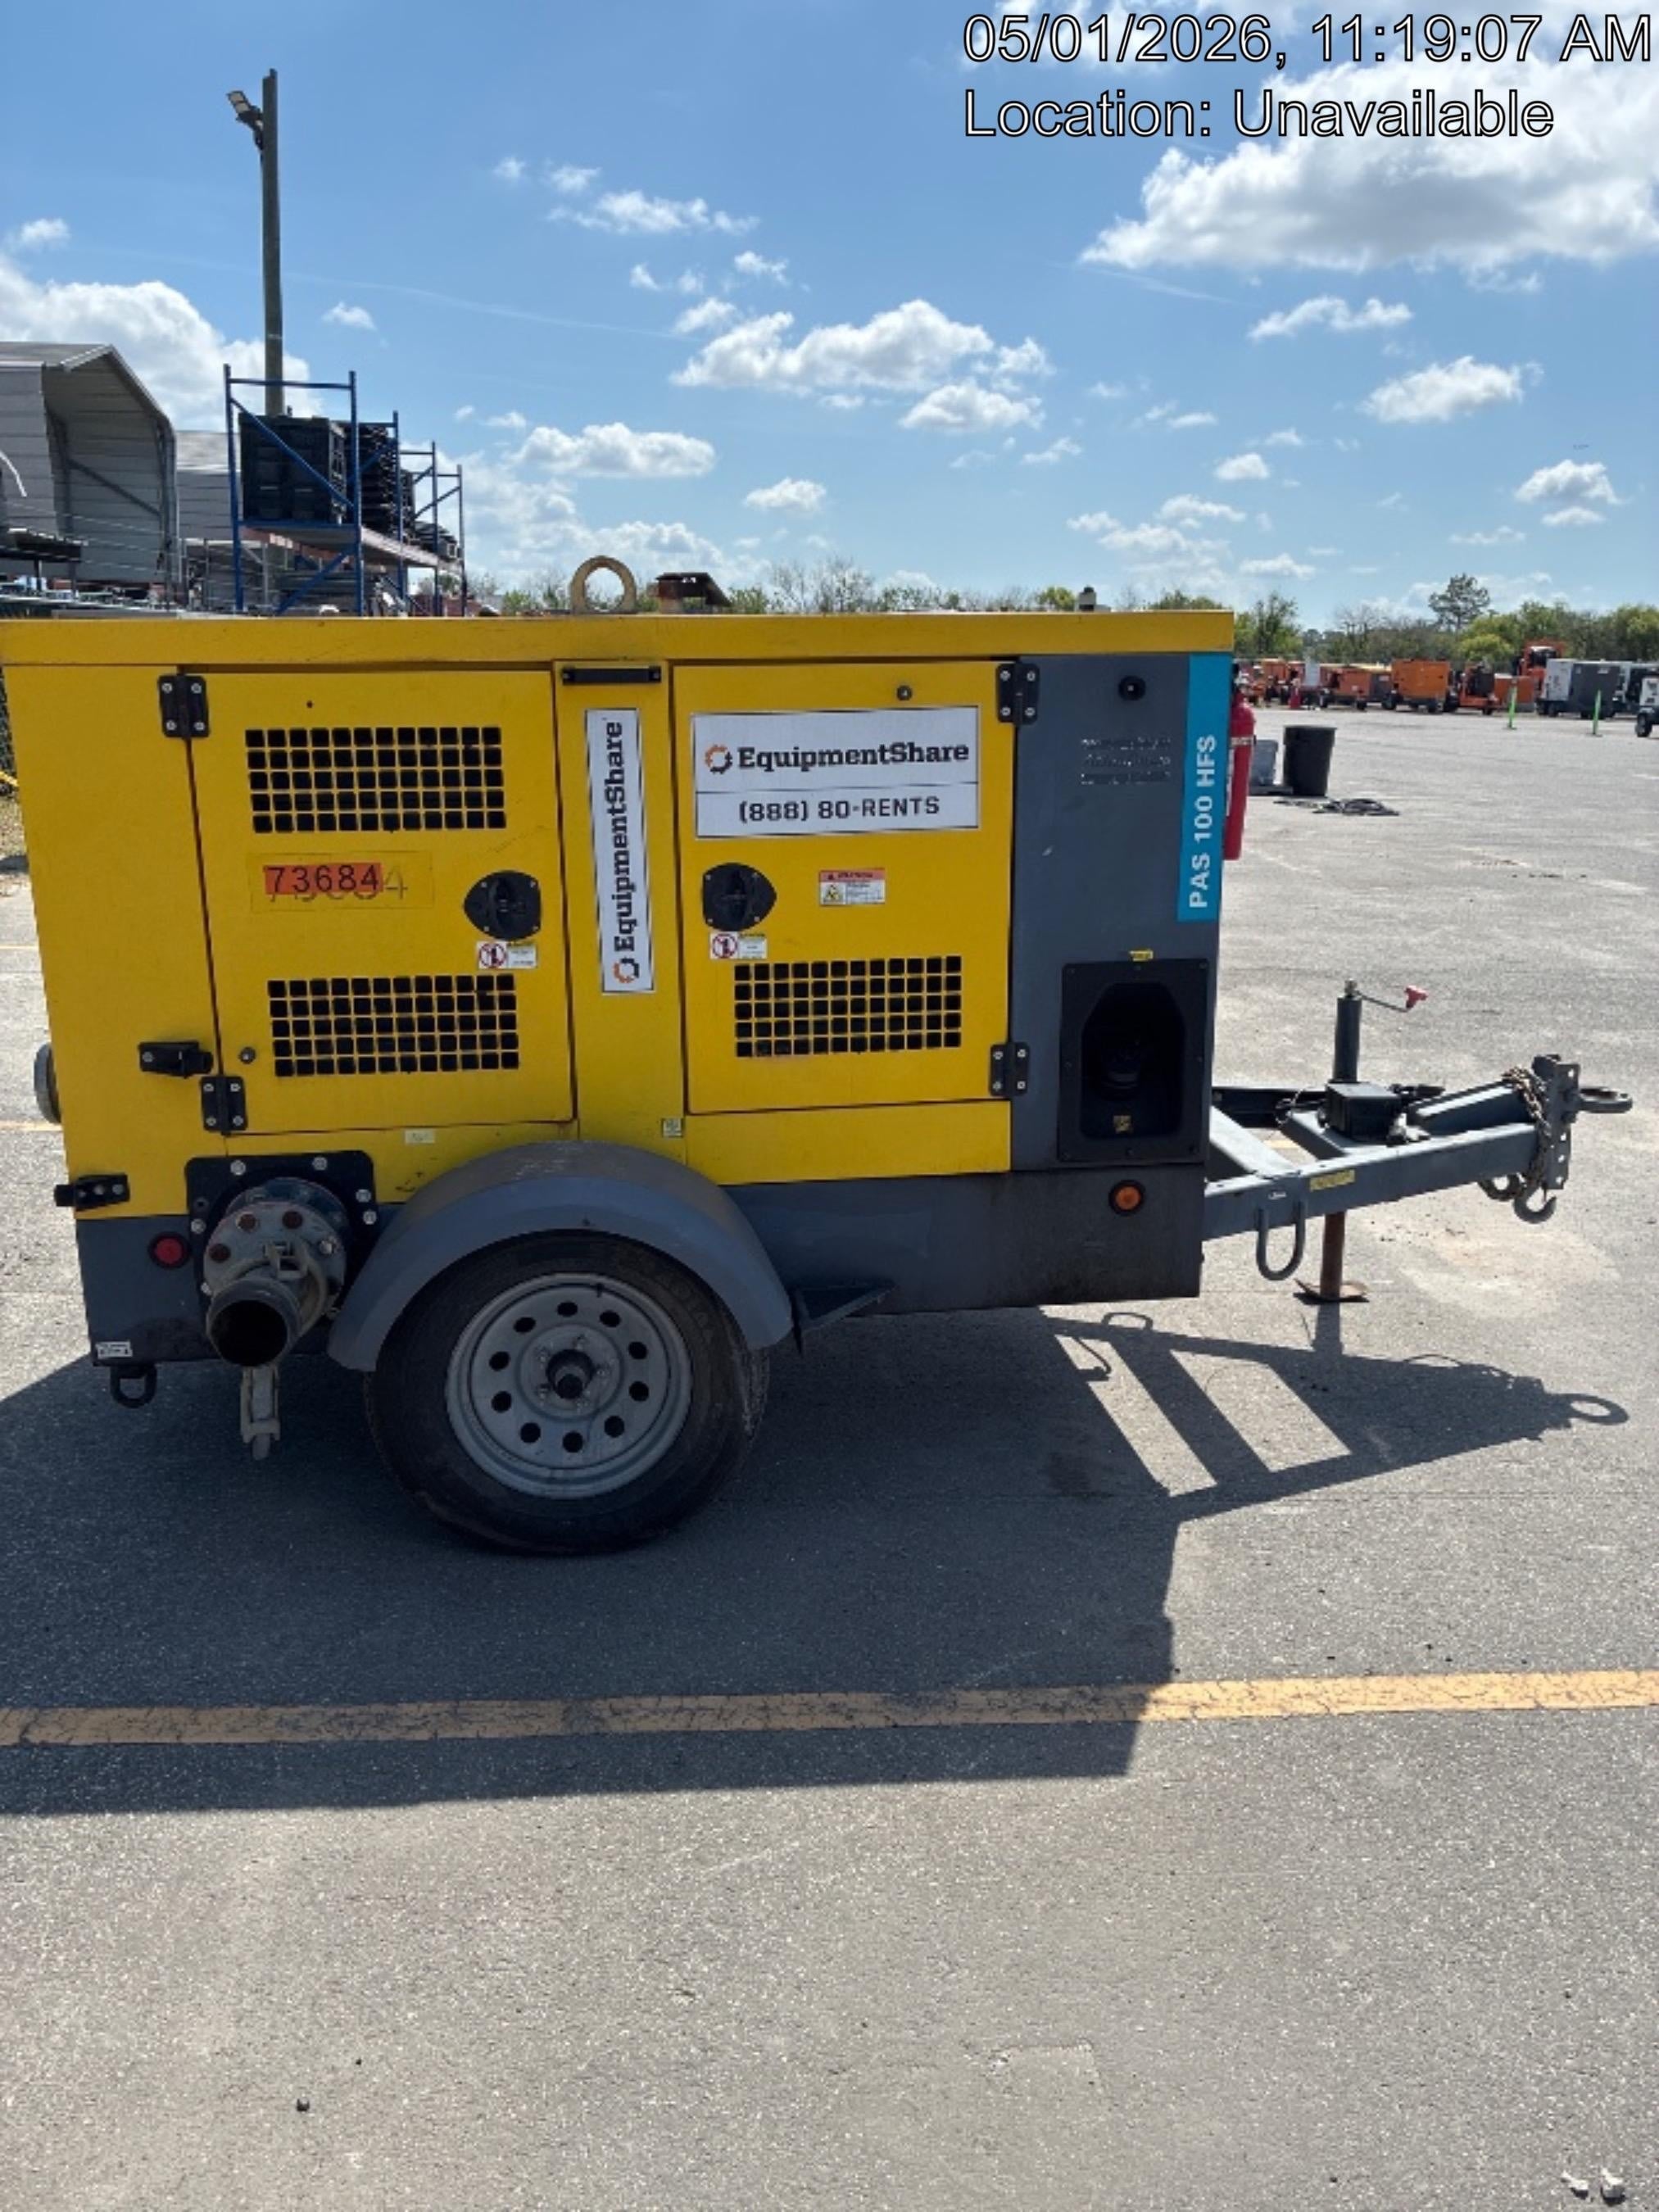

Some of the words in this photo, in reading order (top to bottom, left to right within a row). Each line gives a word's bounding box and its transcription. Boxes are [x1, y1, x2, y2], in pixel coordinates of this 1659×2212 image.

[738, 741, 970, 772] EquipmentShare
[1196, 735, 1217, 787] HFS
[739, 800, 808, 823] (888)
[818, 796, 941, 819] 80-RENTS
[1194, 795, 1213, 842] 100
[604, 722, 638, 952] EquipmentShare
[266, 864, 379, 893] 73684
[1189, 854, 1211, 909] PAS
